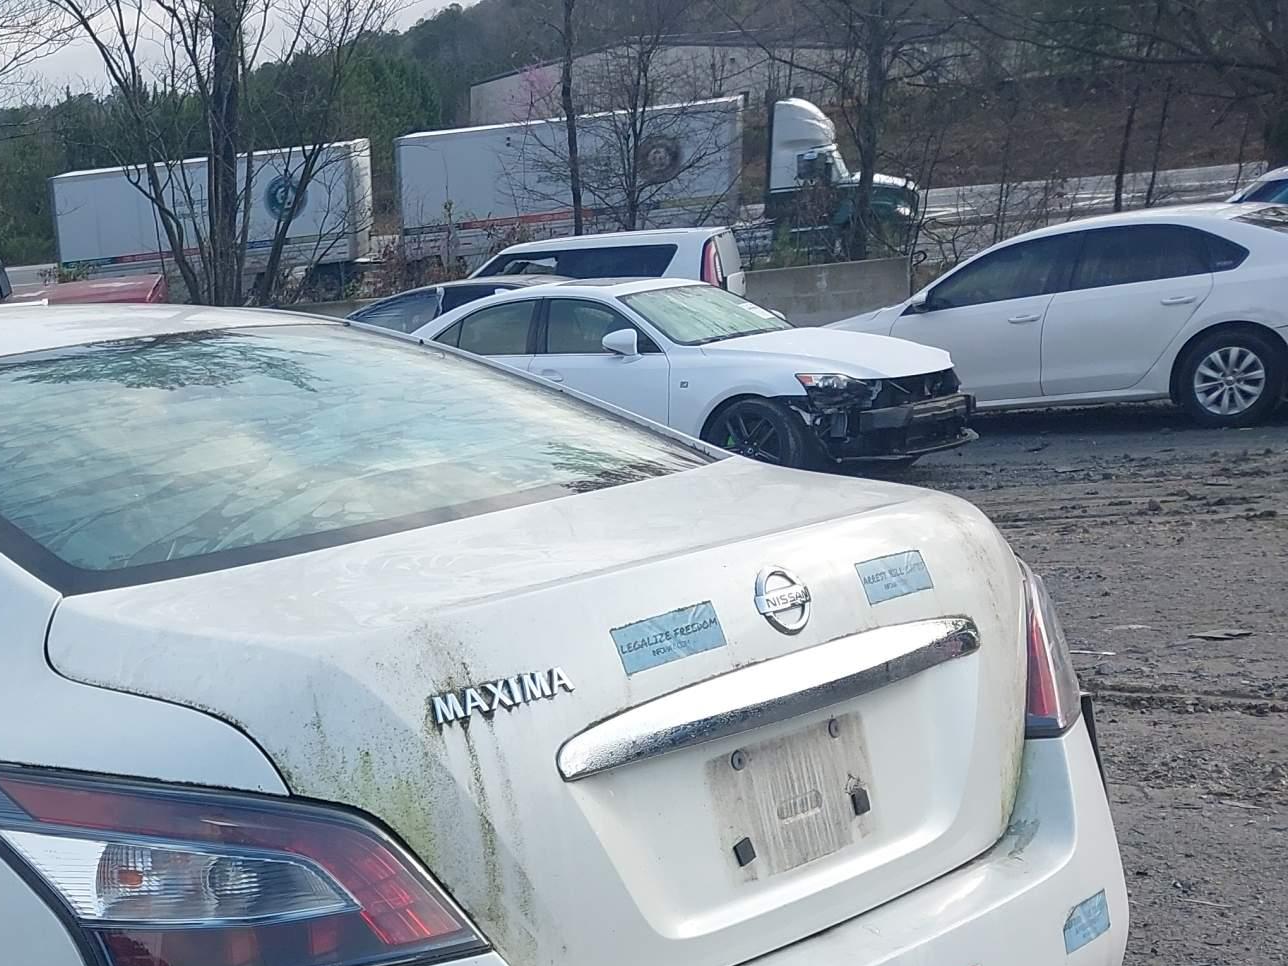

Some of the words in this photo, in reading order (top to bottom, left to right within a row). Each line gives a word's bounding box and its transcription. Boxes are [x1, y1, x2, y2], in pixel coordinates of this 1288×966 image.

[765, 586, 810, 609] NISSAN
[620, 631, 672, 655] LEGALIZE
[673, 617, 718, 638] FREEDOM
[433, 667, 575, 725] MAXIMA
